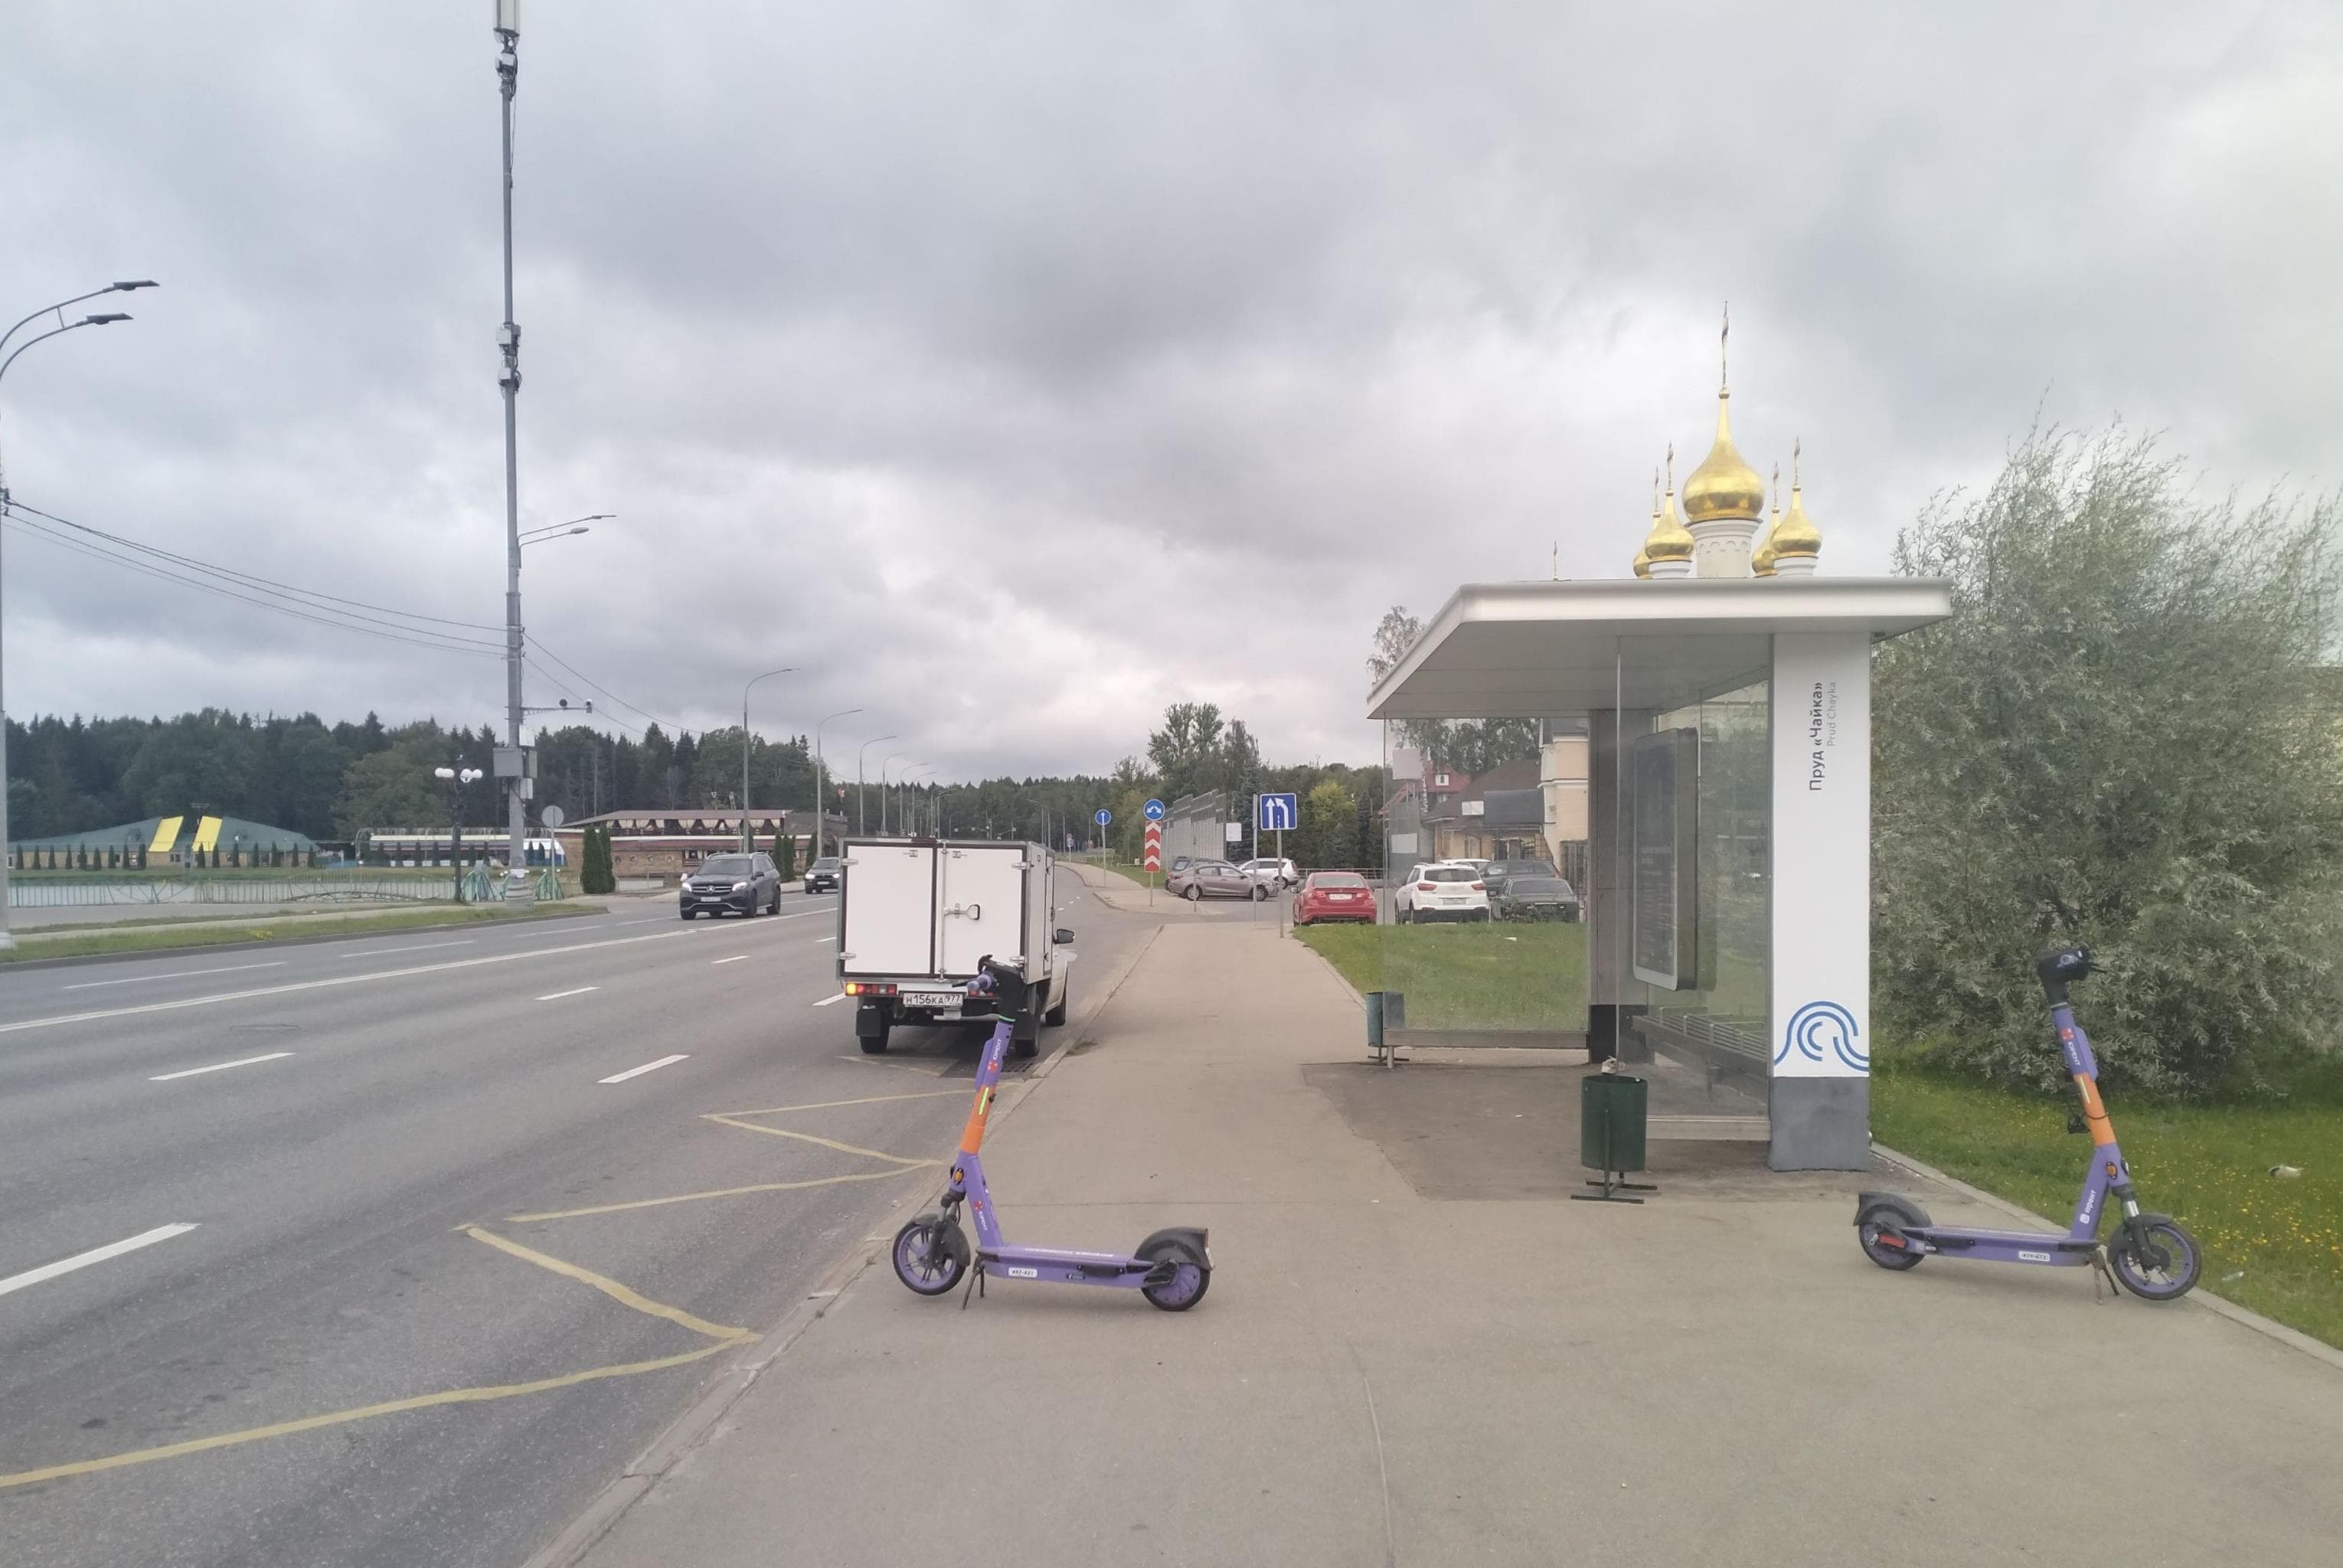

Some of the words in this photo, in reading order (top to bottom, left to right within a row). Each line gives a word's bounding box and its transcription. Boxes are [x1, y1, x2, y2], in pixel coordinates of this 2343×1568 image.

[1809, 682, 1823, 746] «Чайка»
[1827, 681, 1838, 720] Chayka
[1826, 722, 1837, 746] Prud
[1809, 750, 1825, 790] Пруд
